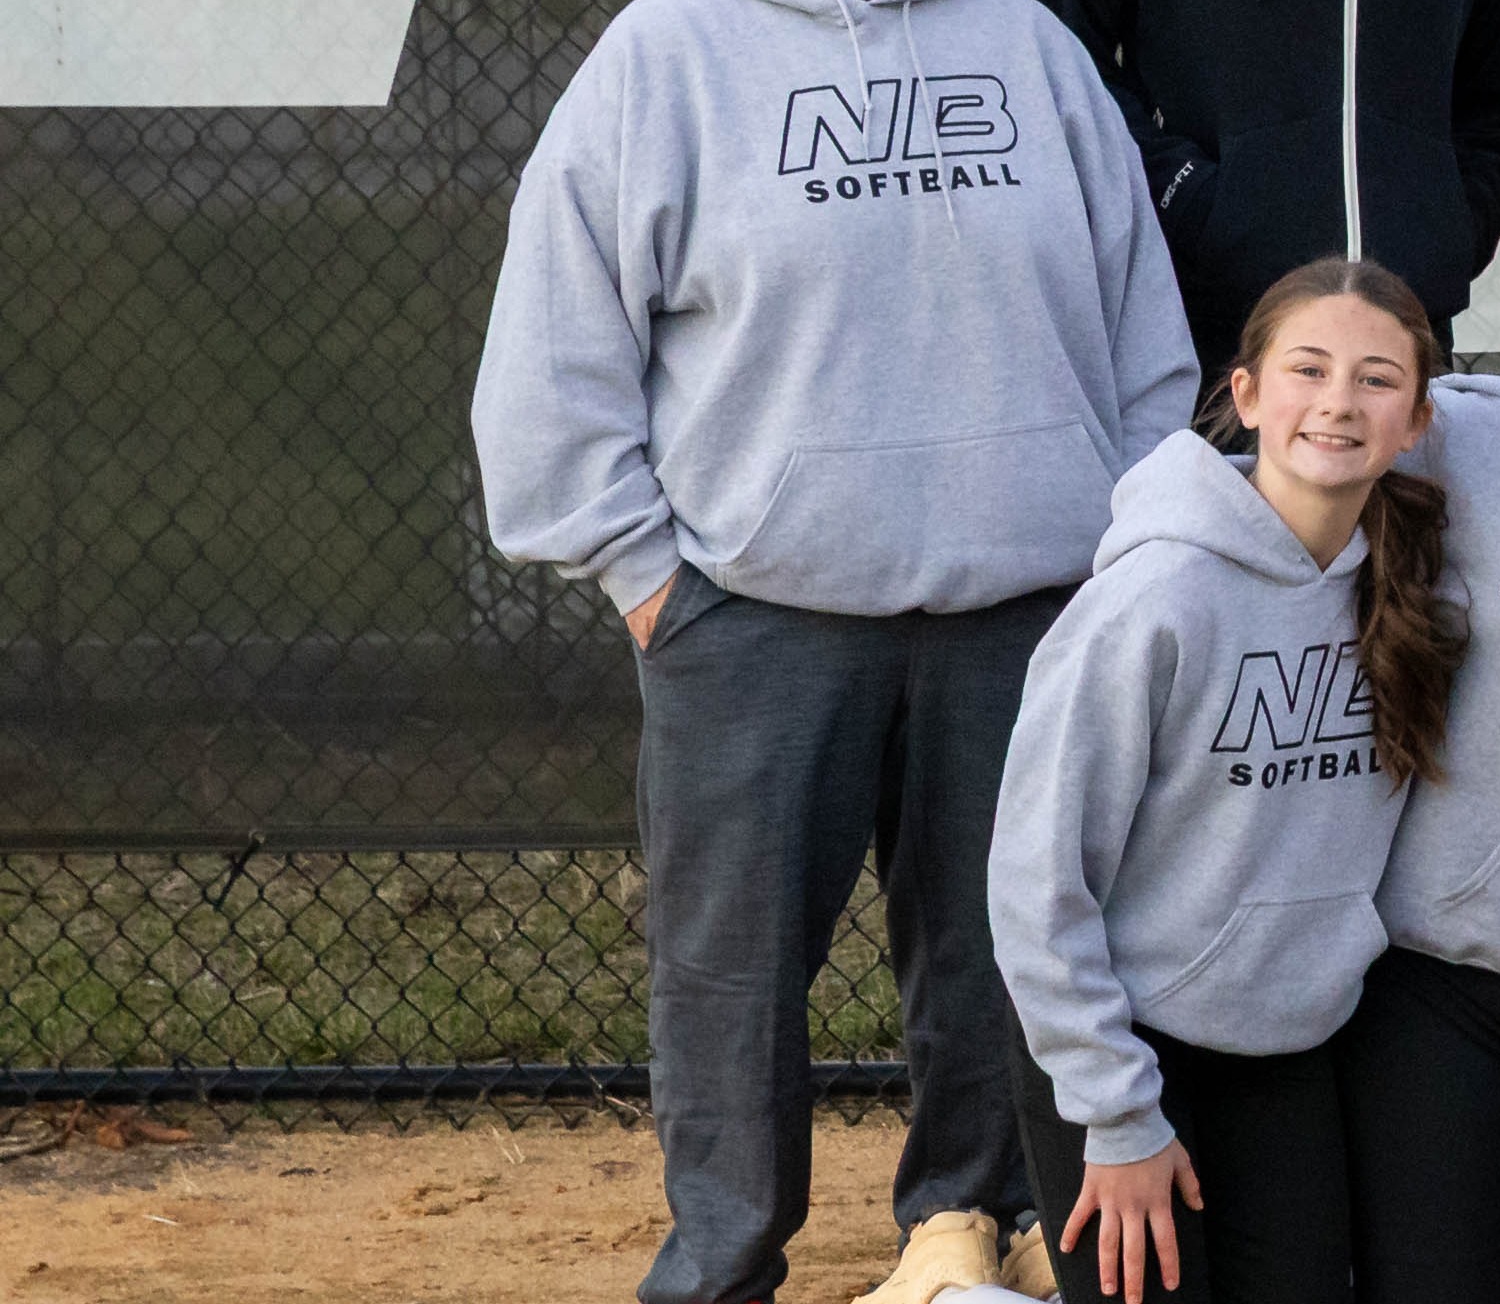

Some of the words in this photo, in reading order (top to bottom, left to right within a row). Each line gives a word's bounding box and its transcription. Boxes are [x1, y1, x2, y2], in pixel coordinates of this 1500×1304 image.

[778, 74, 1018, 175] NB
[804, 163, 1022, 203] SOFTBALL
[1228, 747, 1383, 789] SOFTBAL
